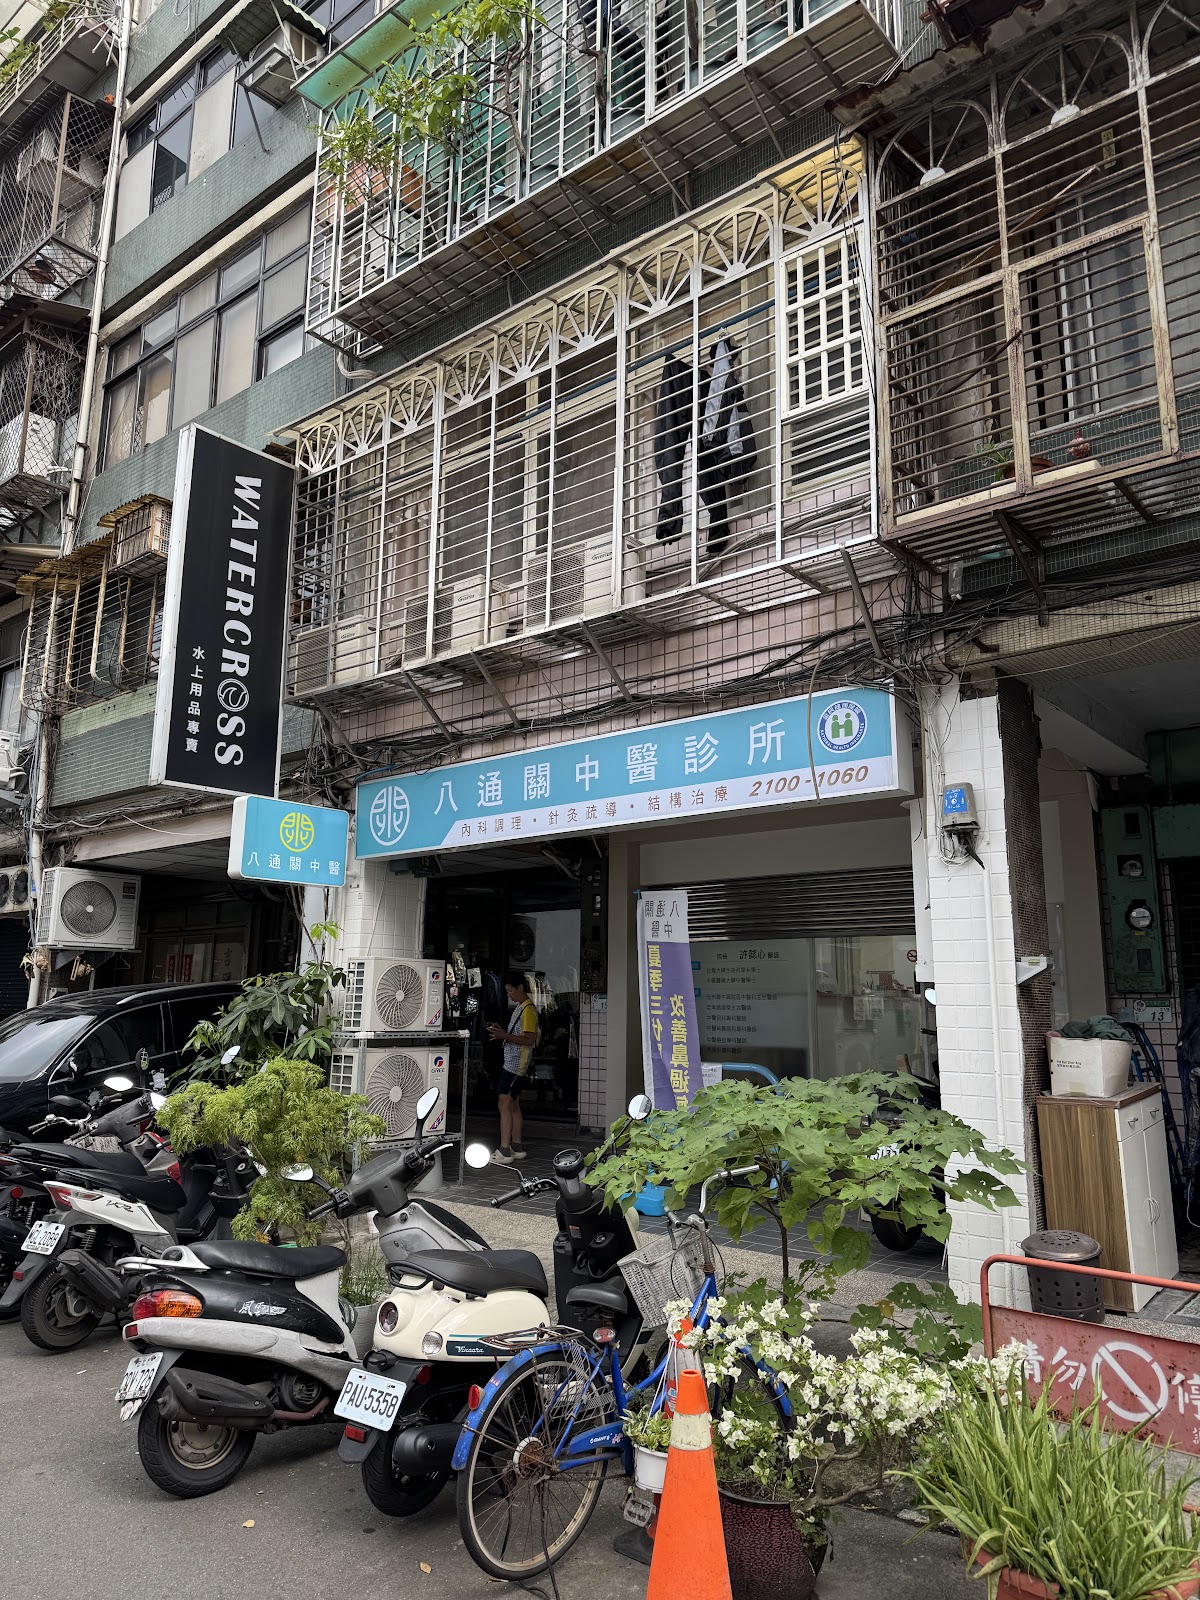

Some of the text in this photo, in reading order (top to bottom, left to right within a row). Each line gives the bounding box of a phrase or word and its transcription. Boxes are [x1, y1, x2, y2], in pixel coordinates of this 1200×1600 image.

[184, 646, 206, 754] 水上用品專賣
[433, 718, 787, 816] 八通關中醫診所
[748, 764, 870, 798] 2100-1060
[247, 851, 340, 876] 八通關中醫
[1151, 1011, 1164, 1021] 13
